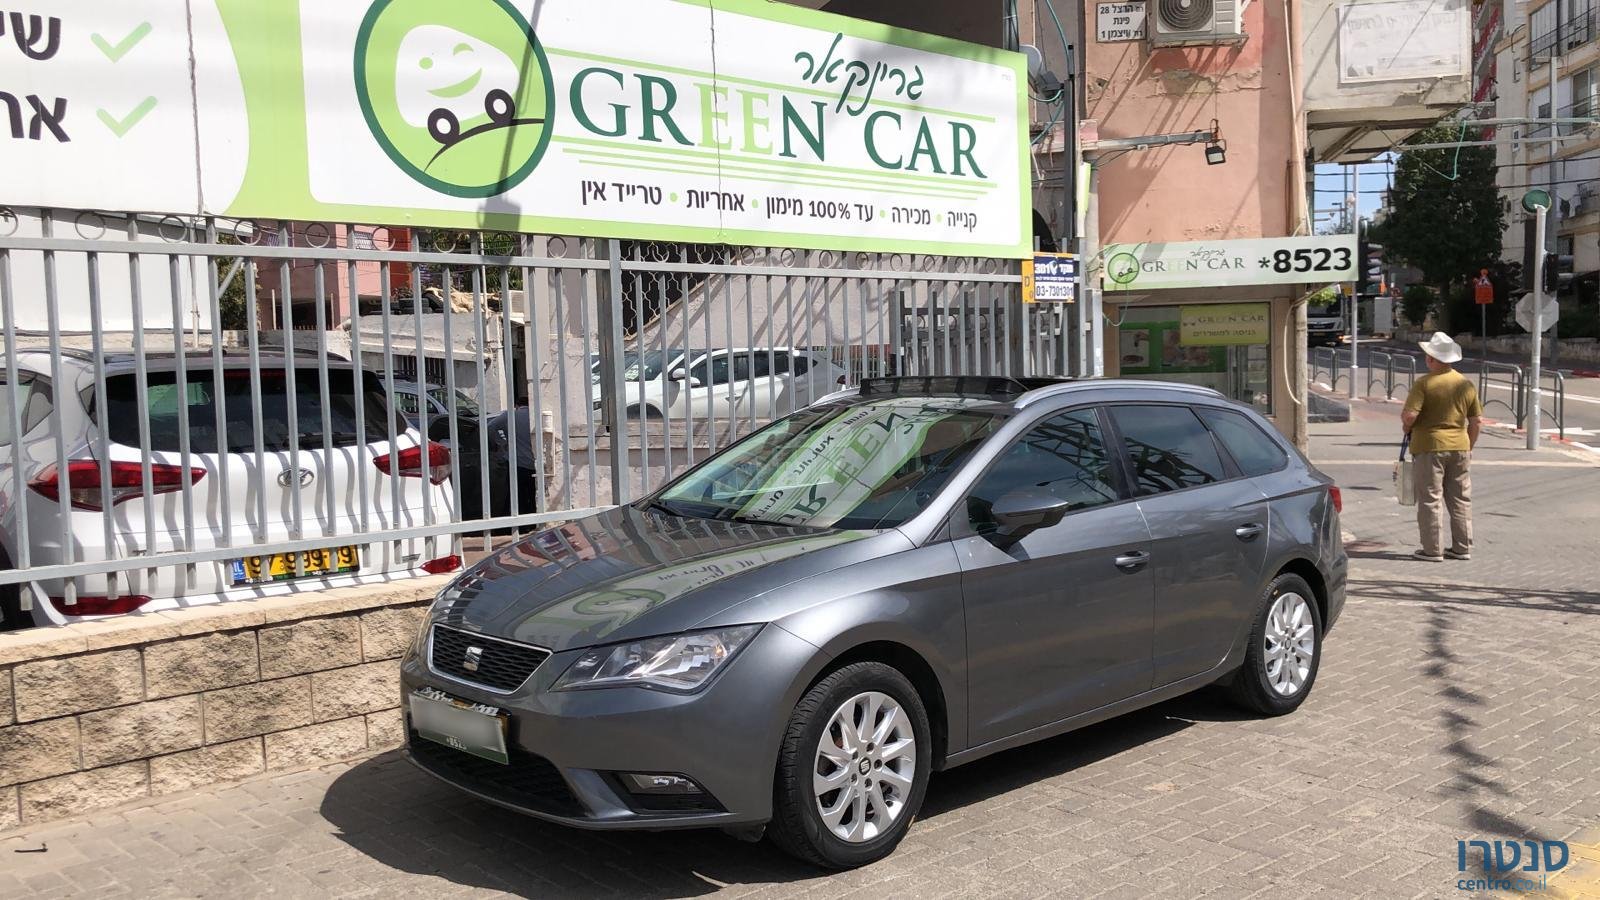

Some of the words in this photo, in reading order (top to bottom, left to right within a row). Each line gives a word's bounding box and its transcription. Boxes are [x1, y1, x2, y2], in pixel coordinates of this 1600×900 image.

[1100, 6, 1110, 14] 28
[1112, 16, 1130, 25] פינת
[1101, 30, 1106, 38] 1
[794, 32, 924, 116] גרינקאר
[569, 67, 828, 162] GREEN
[864, 110, 988, 178] CAR
[581, 180, 607, 206] אין
[612, 182, 662, 205] טרייד
[686, 189, 745, 212] אחריות
[766, 196, 804, 219] מימון
[808, 200, 850, 220] 100%
[854, 203, 874, 223] עד
[892, 206, 931, 225] מכירה
[947, 211, 977, 232] קנייה
[1142, 259, 1198, 273] GREEN
[1207, 257, 1246, 270] CAR
[1241, 314, 1265, 322] CAR
